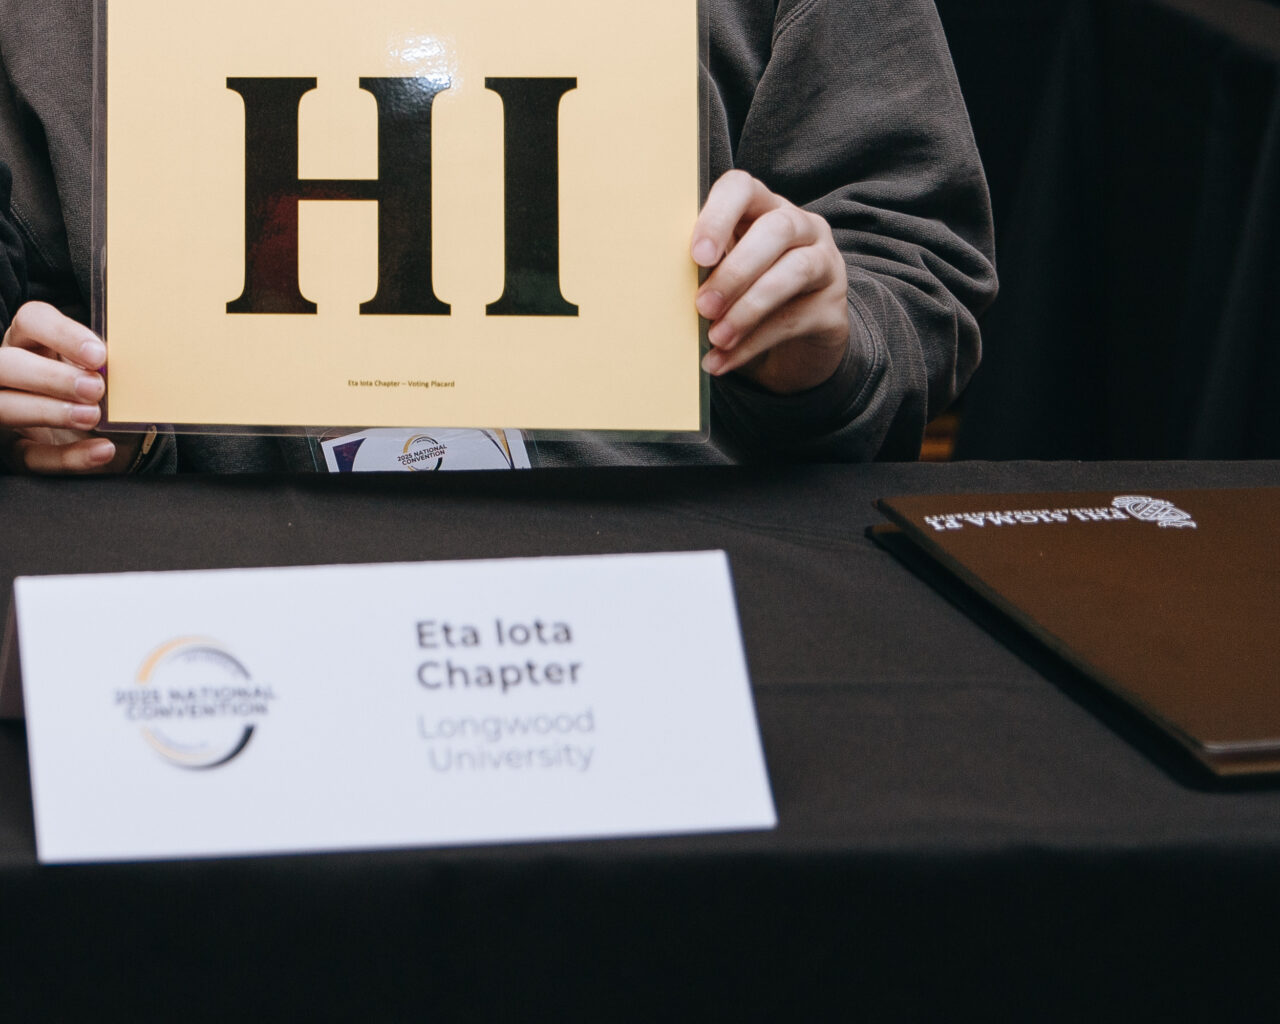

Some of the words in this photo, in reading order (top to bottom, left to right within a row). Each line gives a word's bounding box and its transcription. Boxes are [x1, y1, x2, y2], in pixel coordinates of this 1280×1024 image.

[226, 76, 579, 317] HI
[348, 379, 358, 387] Eta
[360, 379, 373, 387] Iota
[374, 379, 400, 388] Chapter
[408, 379, 429, 388] Voting
[431, 379, 455, 387] Placard
[397, 453, 412, 462] 2025
[413, 444, 447, 457] NATIONAL
[402, 450, 445, 466] CONVENTION
[417, 619, 480, 649] Eta
[496, 618, 573, 647] Iota
[417, 659, 582, 695] Chapter
[169, 685, 277, 702] NATIONAL
[125, 703, 268, 721] CONVENTION
[419, 708, 596, 744] Longwood
[428, 742, 596, 774] University
